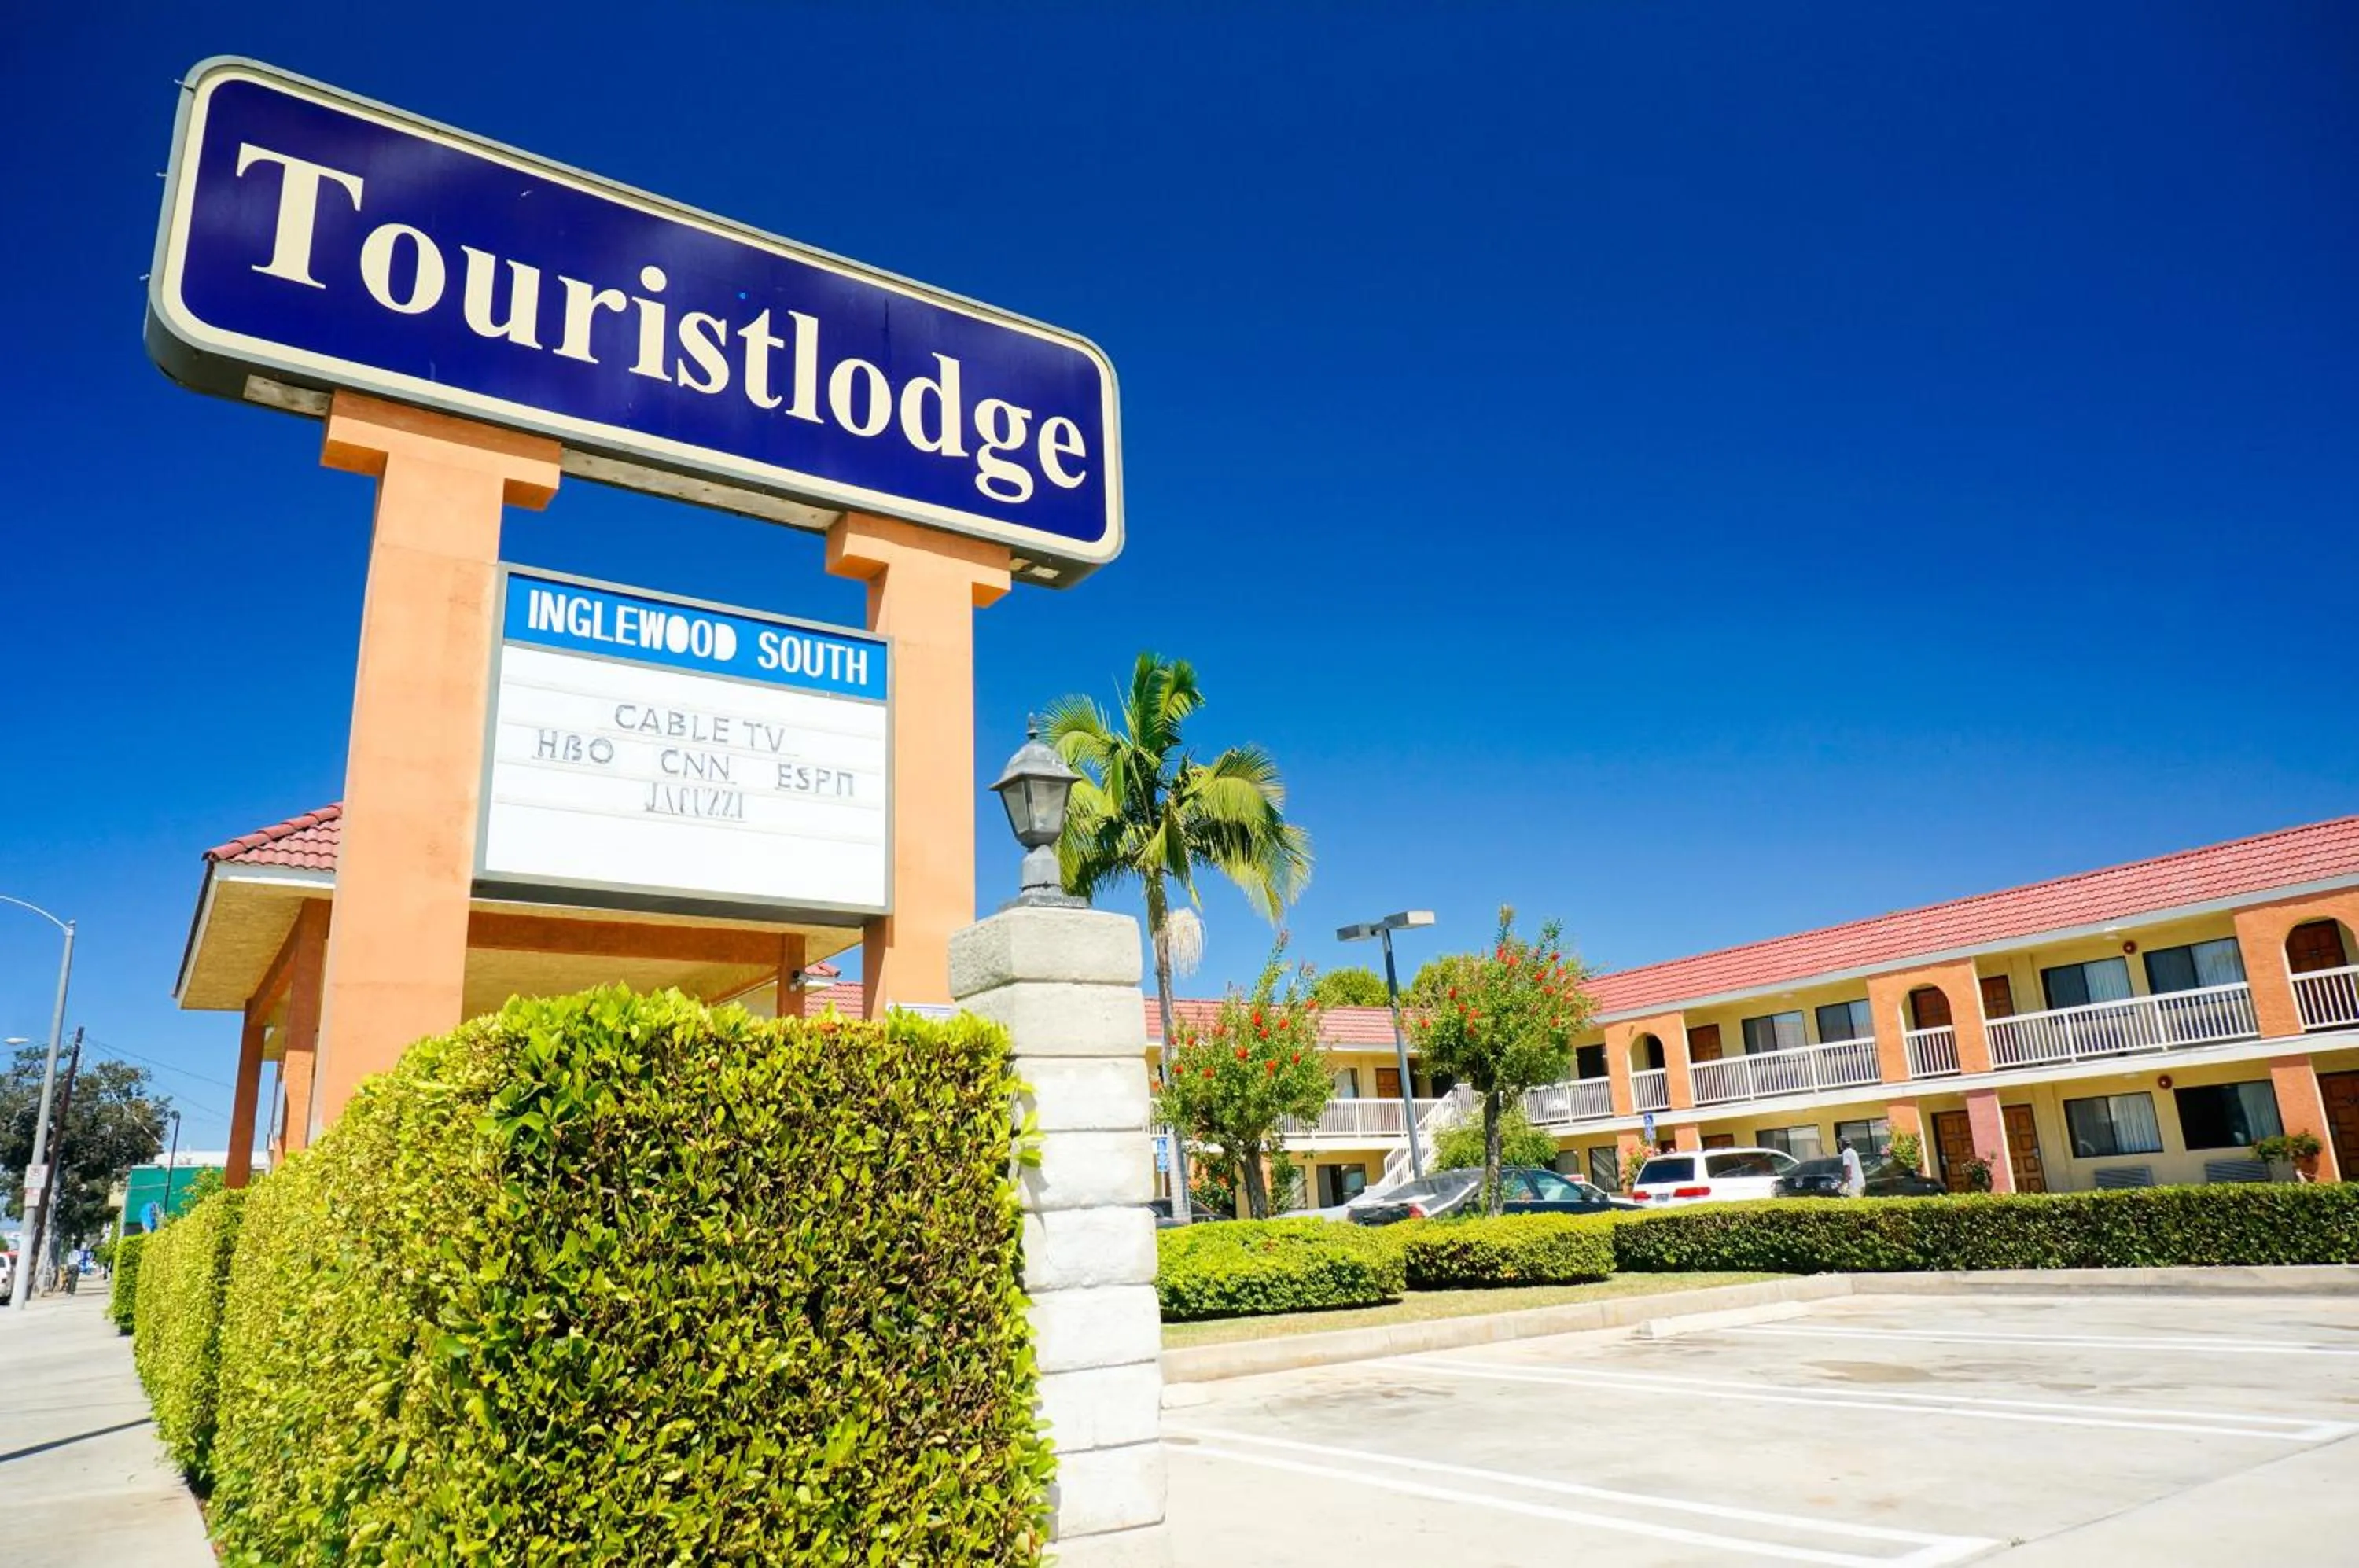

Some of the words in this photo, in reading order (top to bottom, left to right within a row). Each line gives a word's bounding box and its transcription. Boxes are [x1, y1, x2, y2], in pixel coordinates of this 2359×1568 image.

[235, 141, 1088, 504] Touristlodge
[528, 589, 738, 661] INGLEWOOD
[757, 631, 868, 686] SOUTH
[537, 729, 615, 764] HBO
[660, 749, 731, 781] CNN
[777, 762, 854, 797] ESPN
[614, 704, 731, 743] CABLE
[742, 720, 786, 753] TV
